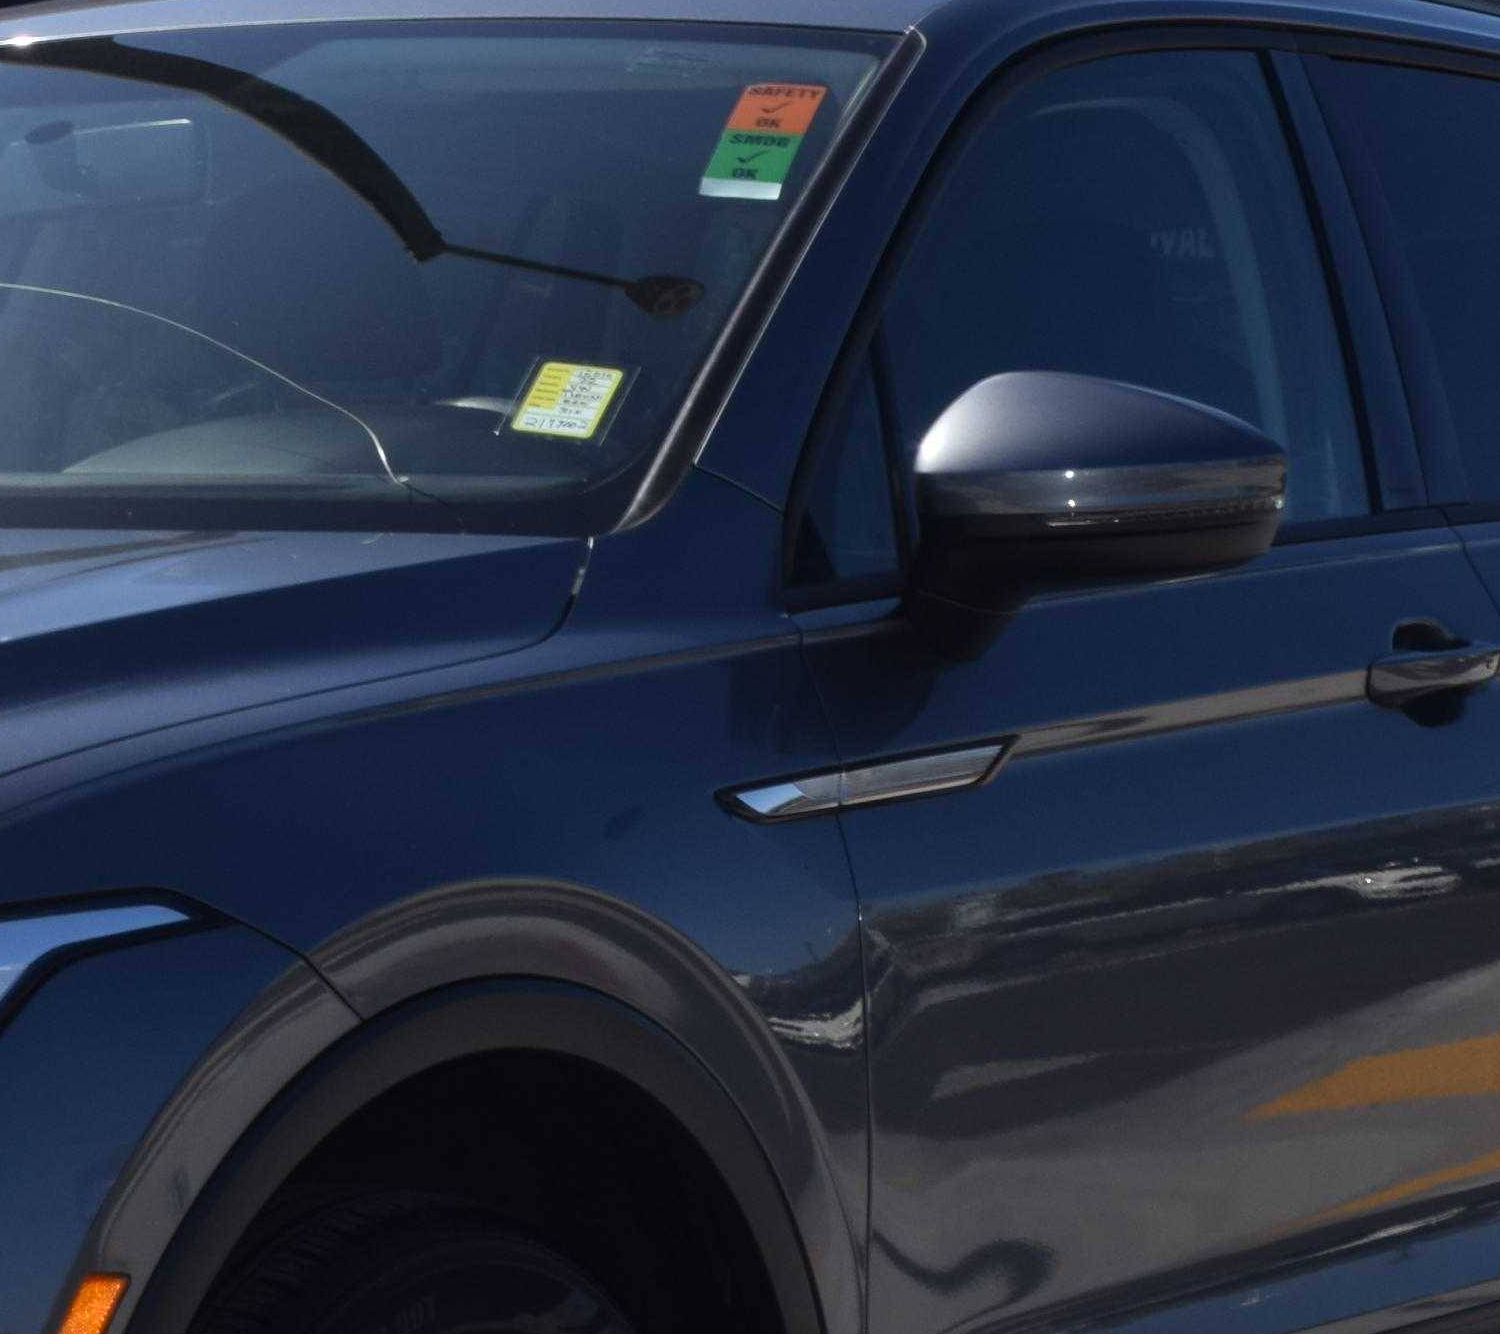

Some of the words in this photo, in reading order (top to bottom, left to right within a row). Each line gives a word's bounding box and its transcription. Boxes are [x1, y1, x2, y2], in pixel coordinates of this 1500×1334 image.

[750, 87, 820, 100] SAFETY
[754, 118, 780, 129] OK
[729, 134, 791, 148] SMOG
[732, 168, 759, 179] OK
